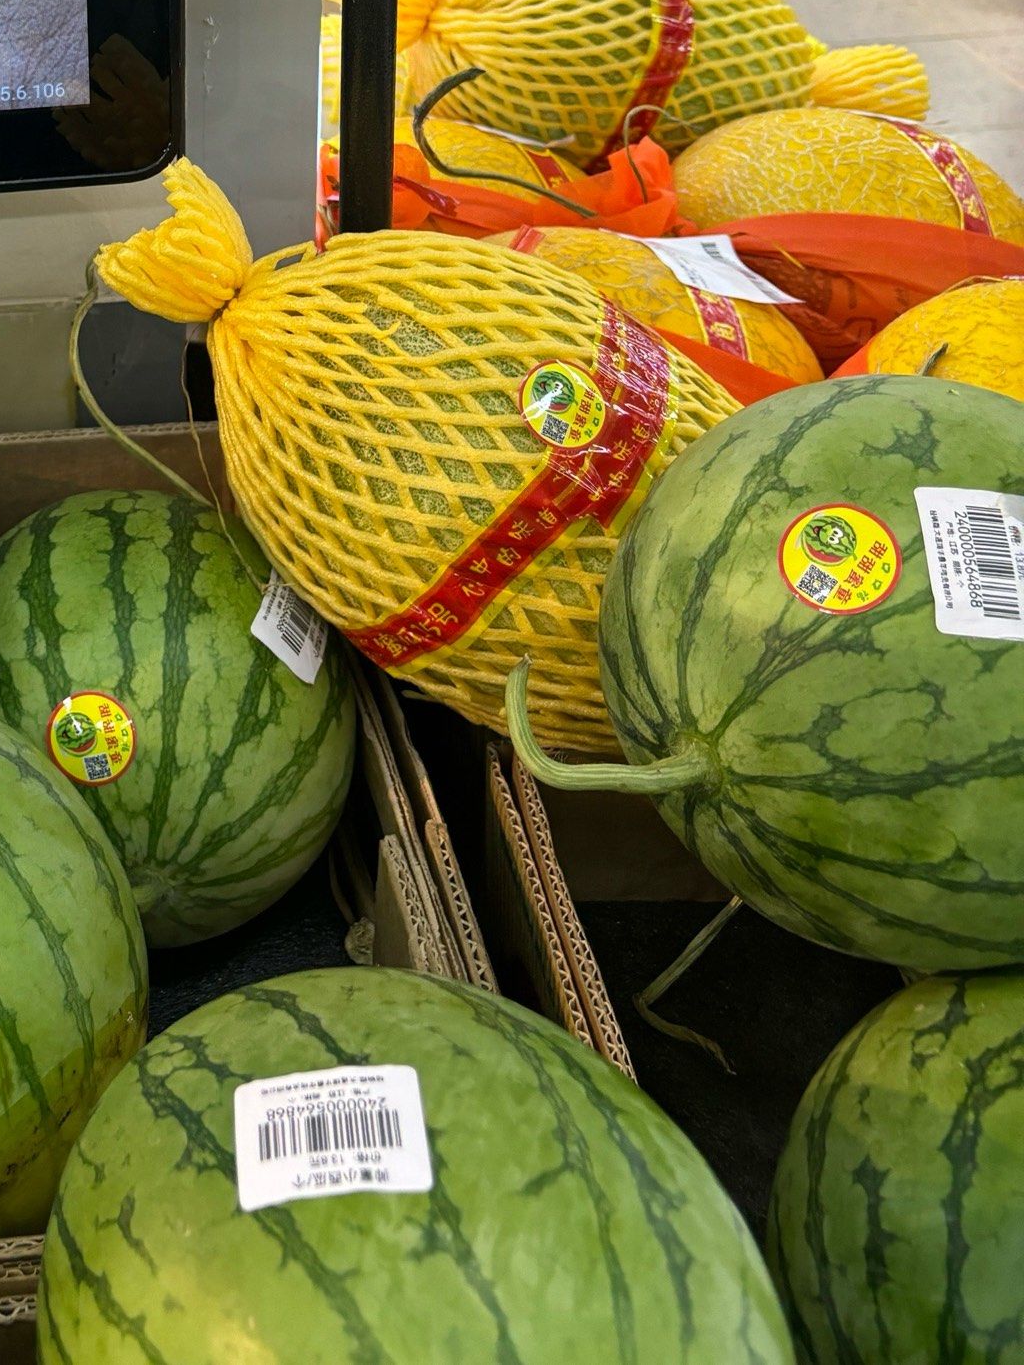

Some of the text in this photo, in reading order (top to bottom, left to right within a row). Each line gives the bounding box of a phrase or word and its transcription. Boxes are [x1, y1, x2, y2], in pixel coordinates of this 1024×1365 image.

[834, 540, 889, 605] 甜甜蜜童
[953, 508, 983, 609] 240000564868
[266, 1095, 384, 1121] 240000564868
